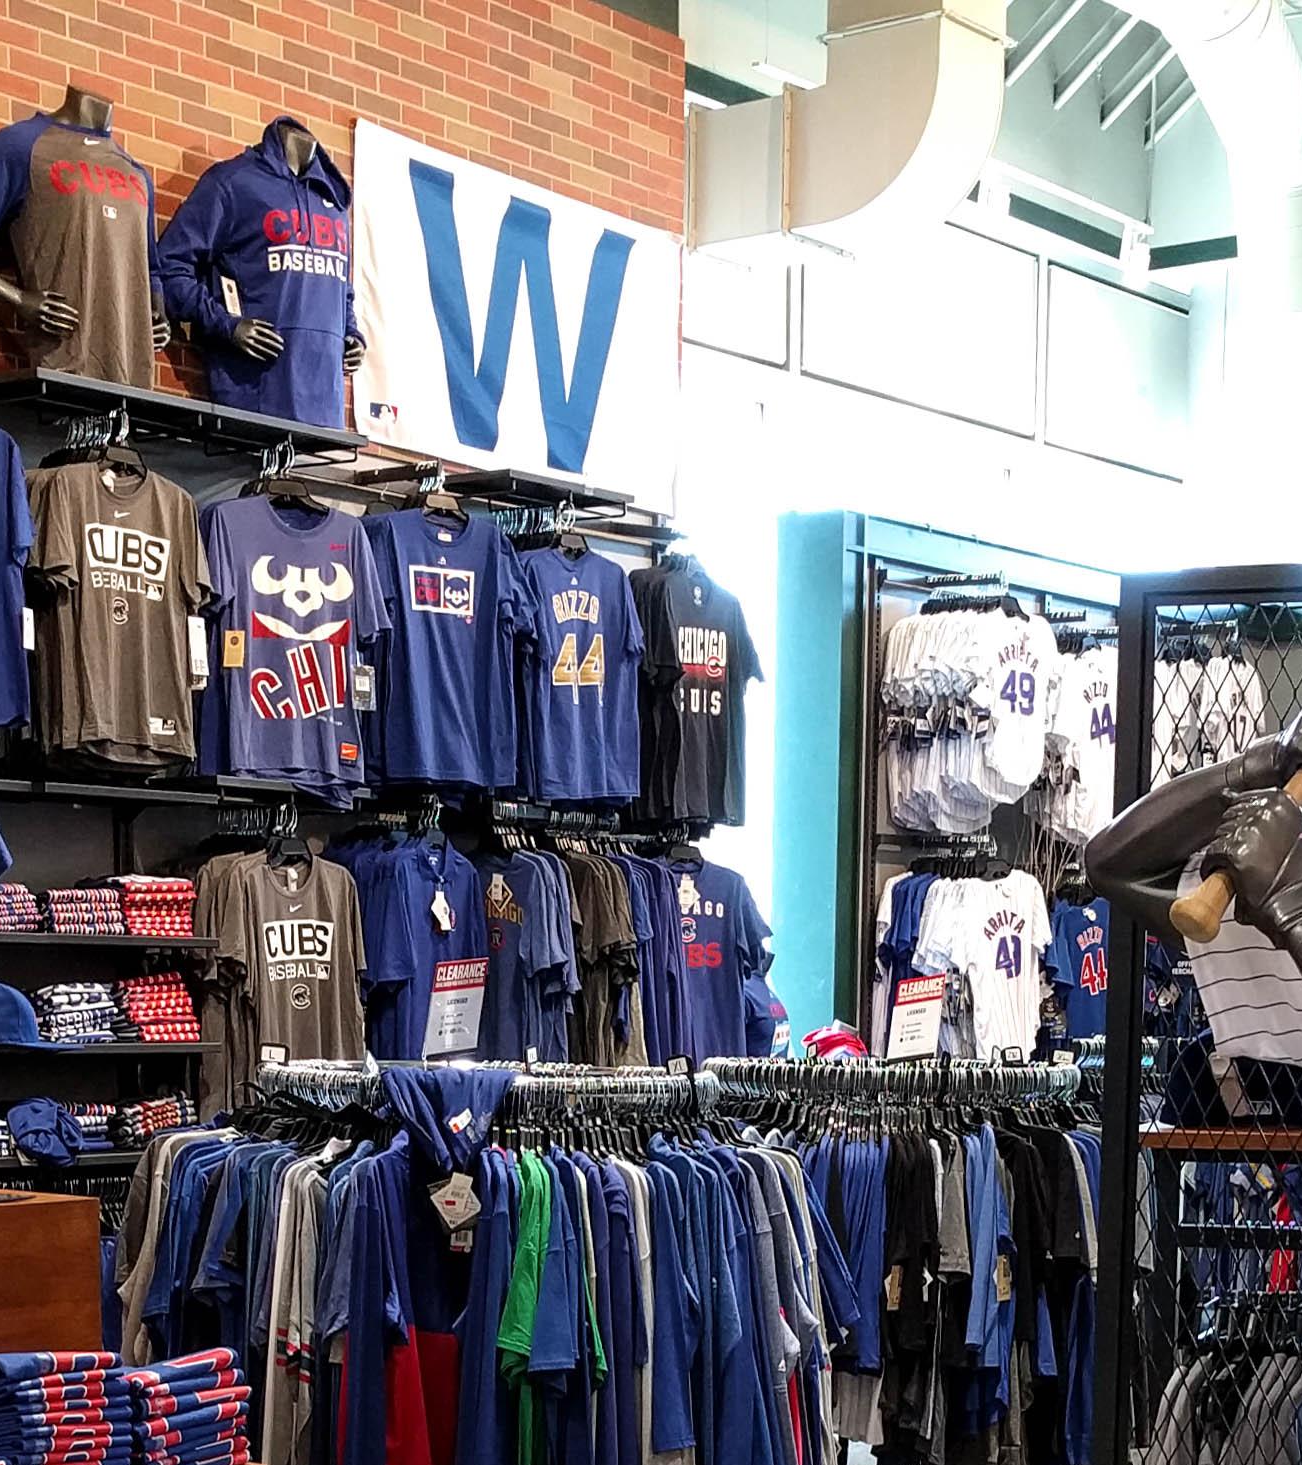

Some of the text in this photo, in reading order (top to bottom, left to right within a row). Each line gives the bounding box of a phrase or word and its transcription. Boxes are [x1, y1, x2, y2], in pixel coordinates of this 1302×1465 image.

[408, 157, 635, 474] W
[551, 633, 606, 706] 44
[999, 669, 1036, 716] 49
[1089, 703, 1116, 749] 44
[265, 923, 329, 959] CUBS
[436, 962, 487, 982] CLEARANCE
[899, 977, 945, 996] CLEARANCE
